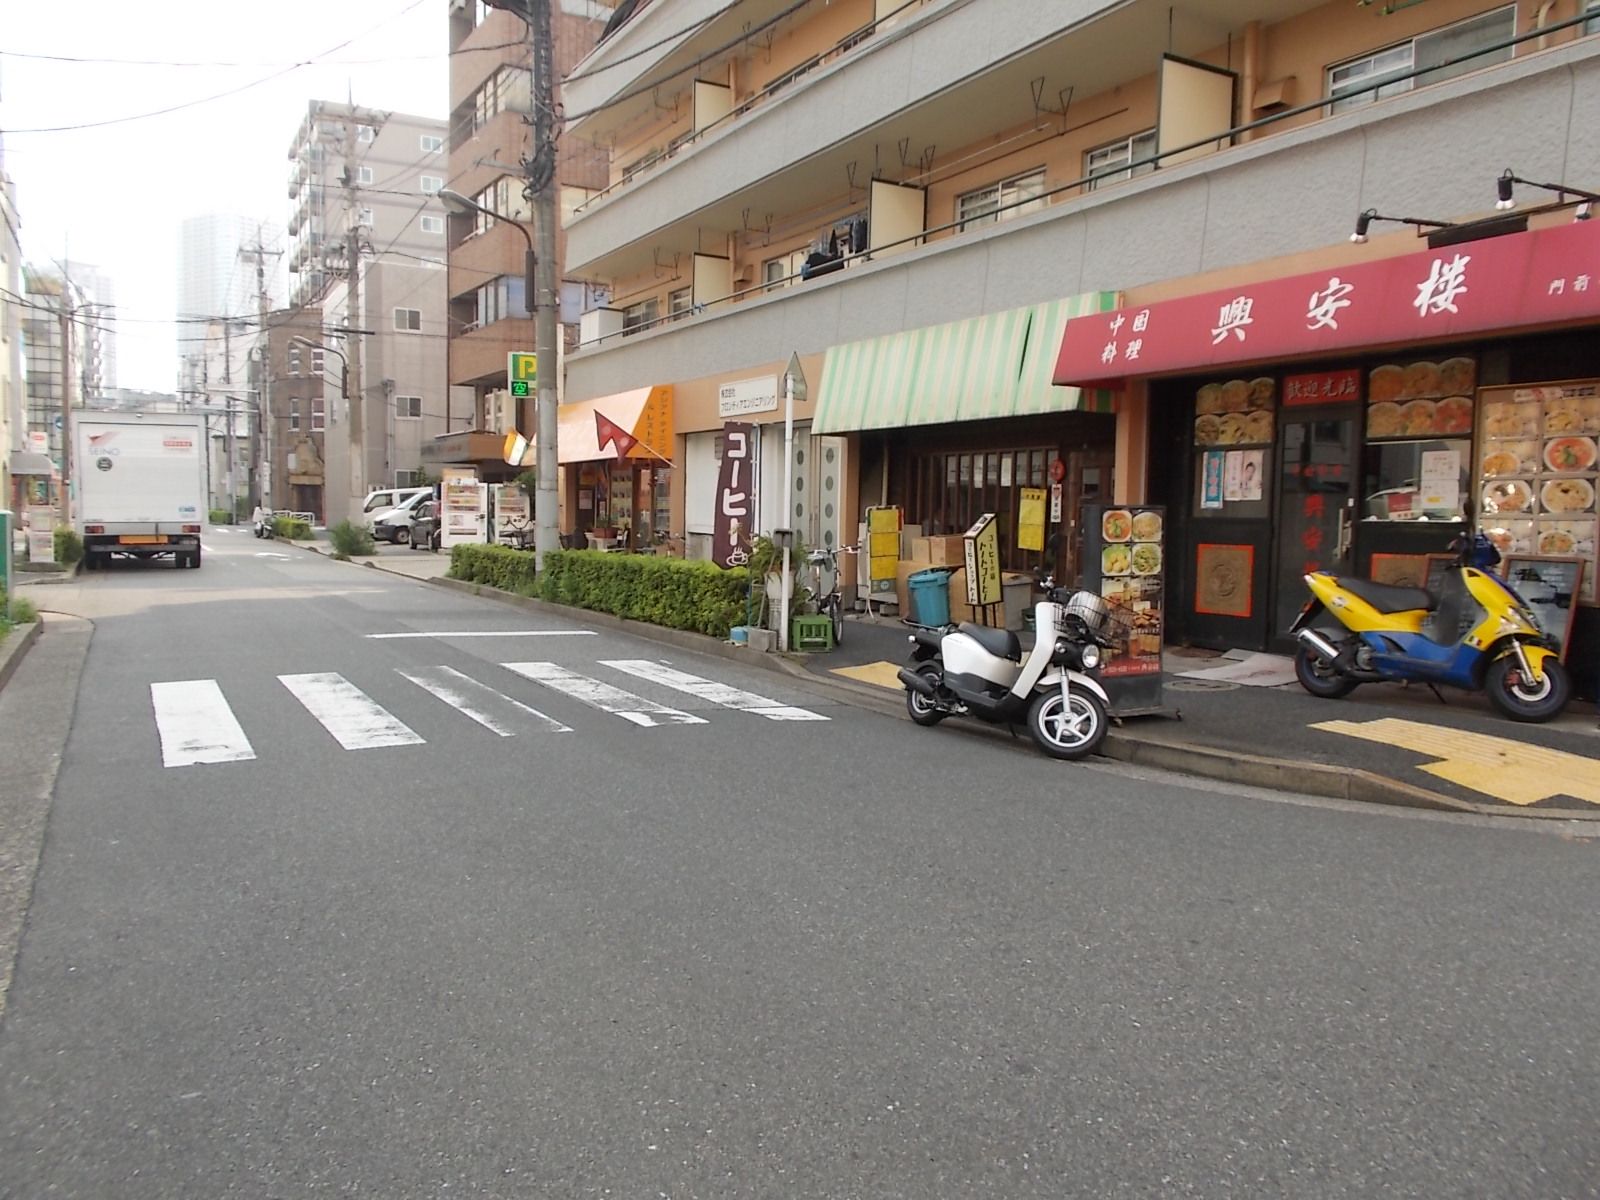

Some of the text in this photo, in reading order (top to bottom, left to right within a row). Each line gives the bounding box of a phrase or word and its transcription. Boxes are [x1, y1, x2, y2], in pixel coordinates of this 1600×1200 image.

[1110, 309, 1150, 337] 中国
[1101, 338, 1143, 365] 料理
[519, 356, 537, 379] P
[723, 433, 747, 546] コーヒー
